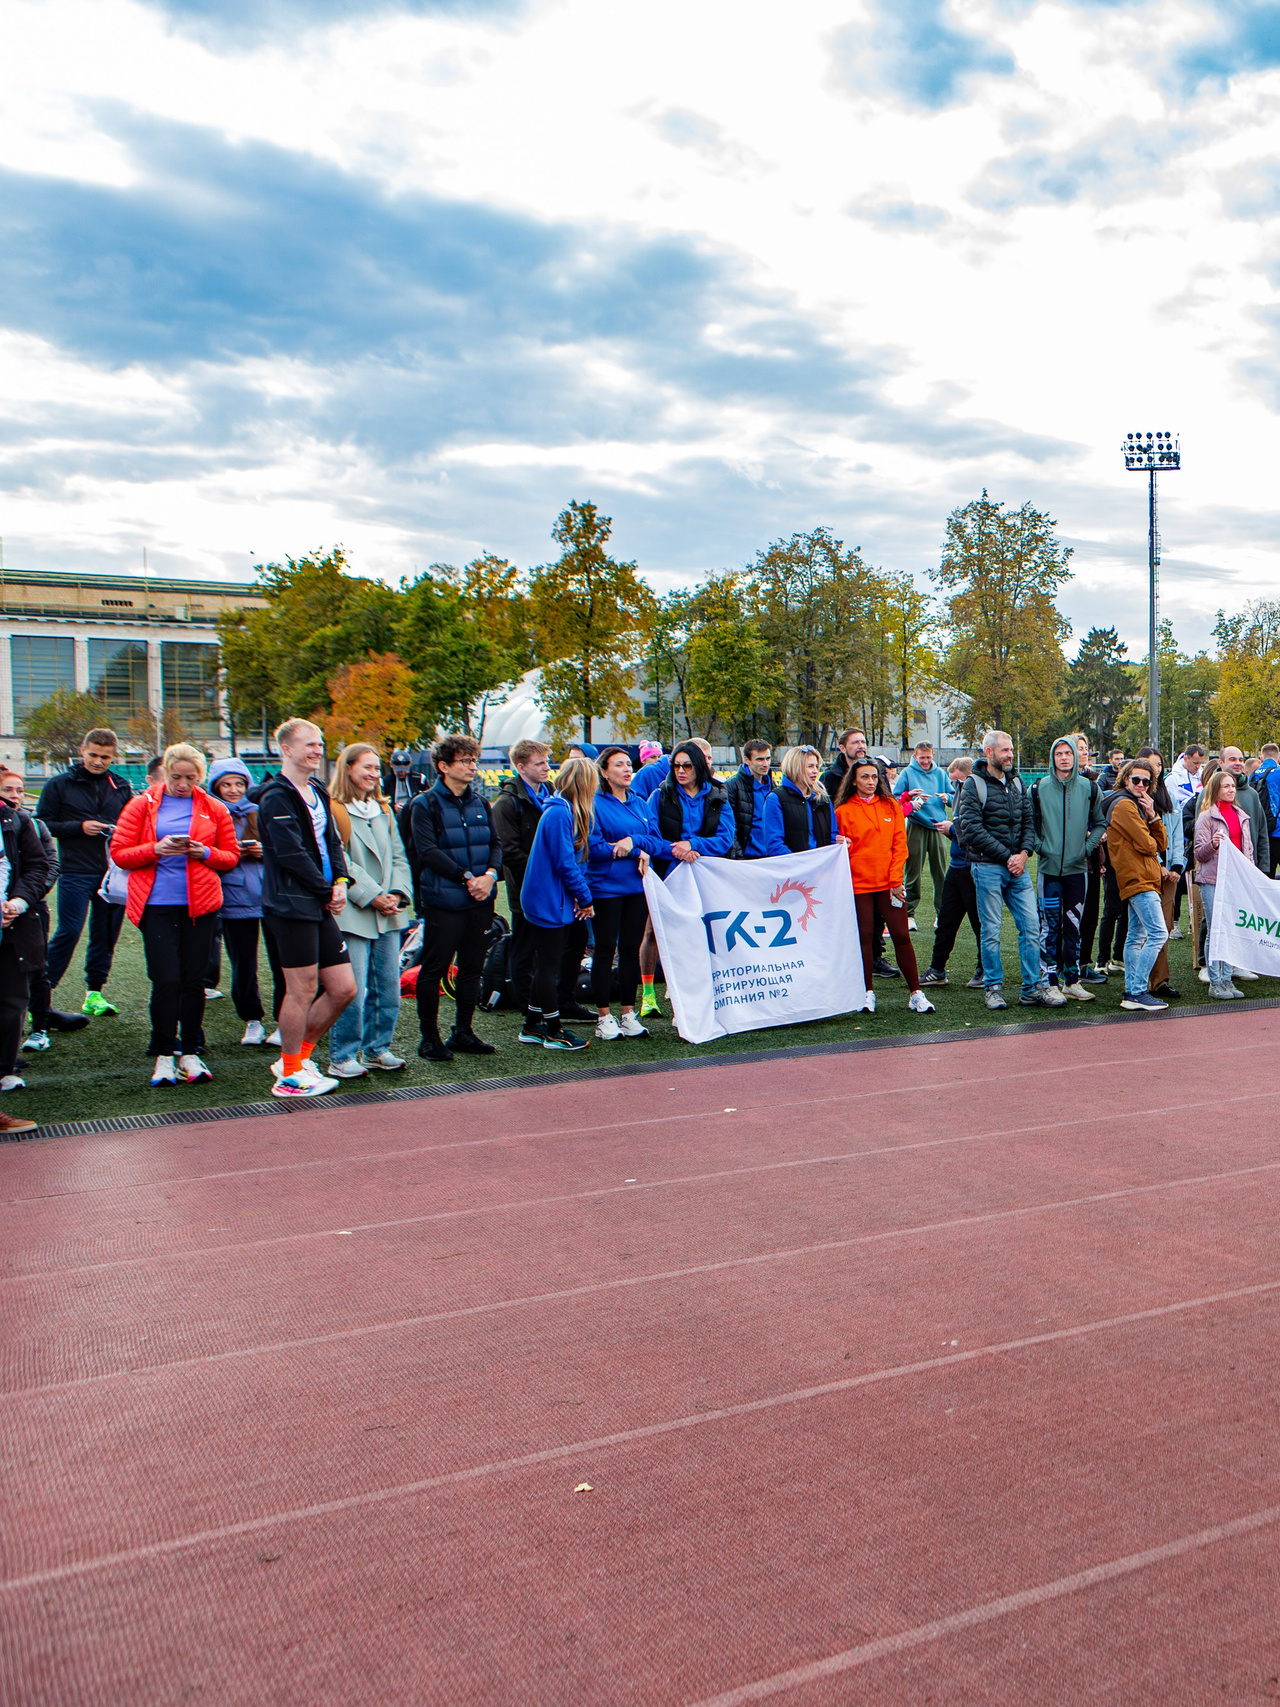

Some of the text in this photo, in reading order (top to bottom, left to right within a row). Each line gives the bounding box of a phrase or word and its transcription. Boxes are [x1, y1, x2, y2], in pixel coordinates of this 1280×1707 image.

[701, 909, 798, 955] ГК-2
[712, 960, 805, 982] РРИТОРИАЛЬНАЯ
[714, 974, 793, 996] НЕРИРУЮЩАЯ
[714, 991, 765, 1010] ОМПАНИЯ
